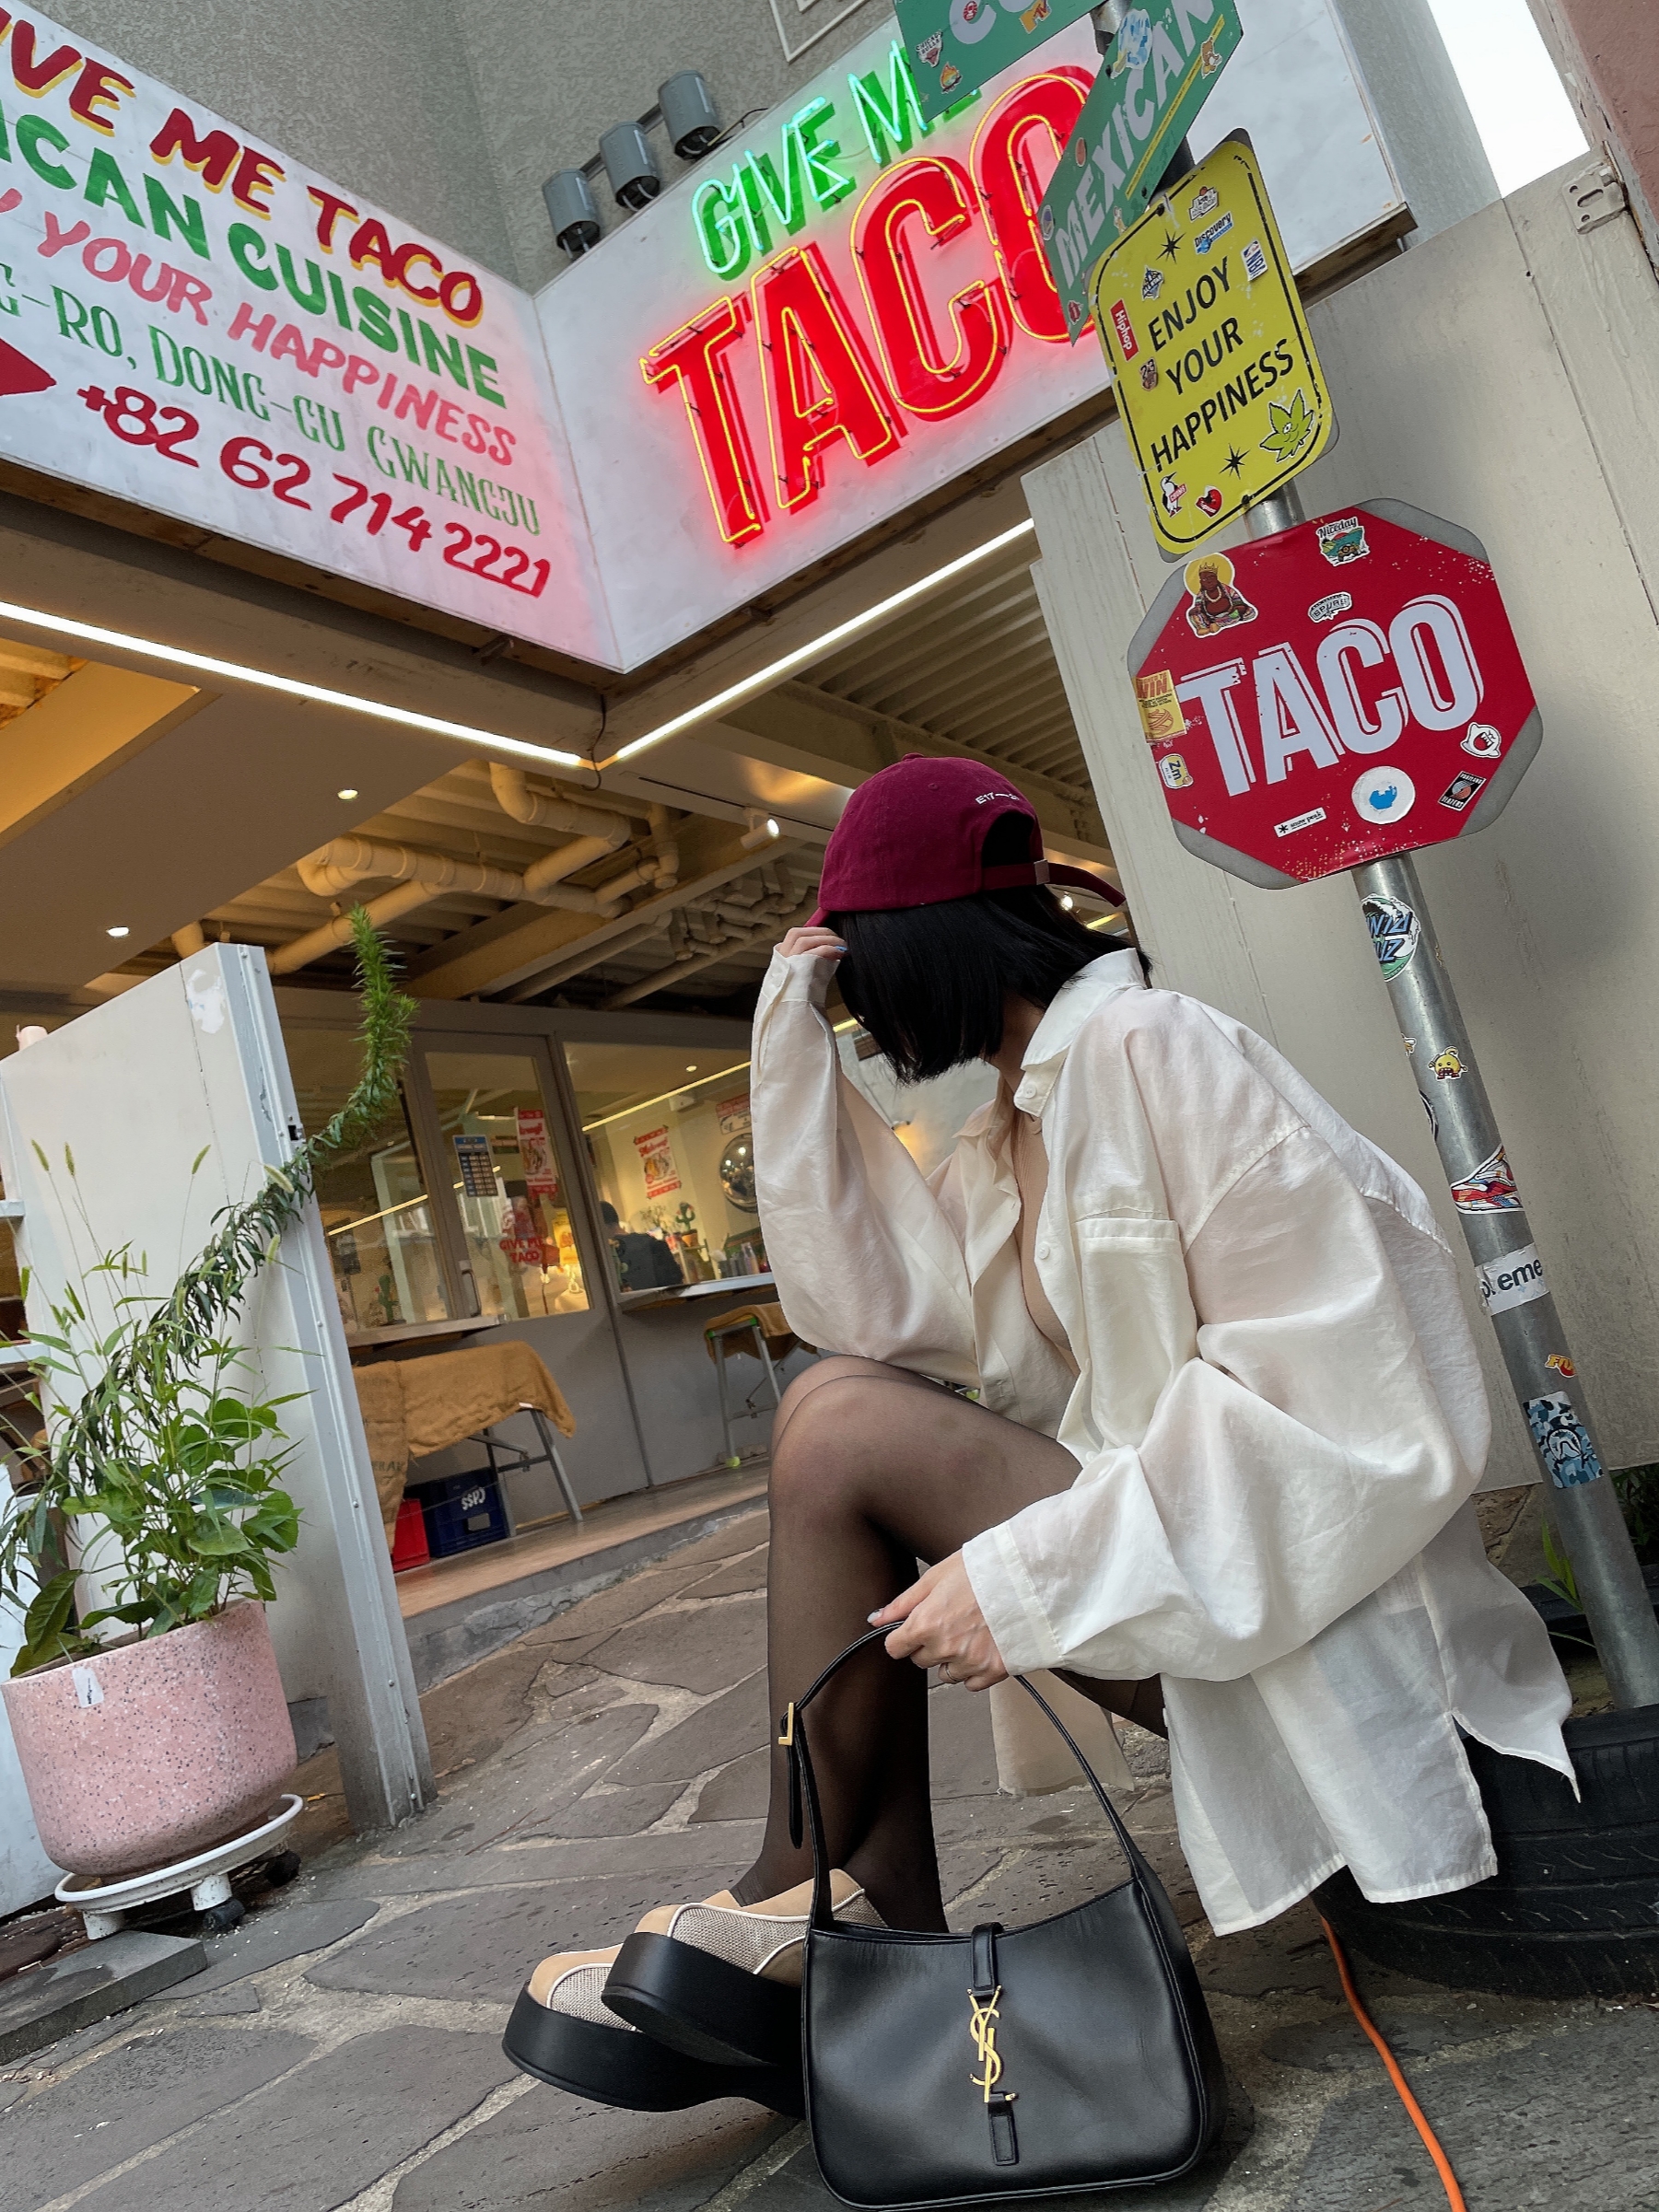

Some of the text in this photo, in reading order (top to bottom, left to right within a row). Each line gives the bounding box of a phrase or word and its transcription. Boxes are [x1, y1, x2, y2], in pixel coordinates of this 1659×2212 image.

[149, 107, 286, 220] ME
[307, 185, 484, 330] TACO
[692, 97, 856, 282] GIVE
[848, 41, 982, 168] M
[1055, 0, 1214, 290] MEXICAN
[38, 211, 517, 467] YOUR HAPPINESS
[228, 223, 507, 409] CUISINE
[639, 65, 1094, 549] TACO
[1116, 309, 1133, 351] Hiphop
[1148, 256, 1231, 352] ENJOY
[1150, 338, 1294, 472] HAPPINESS
[1165, 317, 1244, 395] YOUR
[76, 385, 551, 599] +82 62 714 2221
[1174, 594, 1484, 797] TACO
